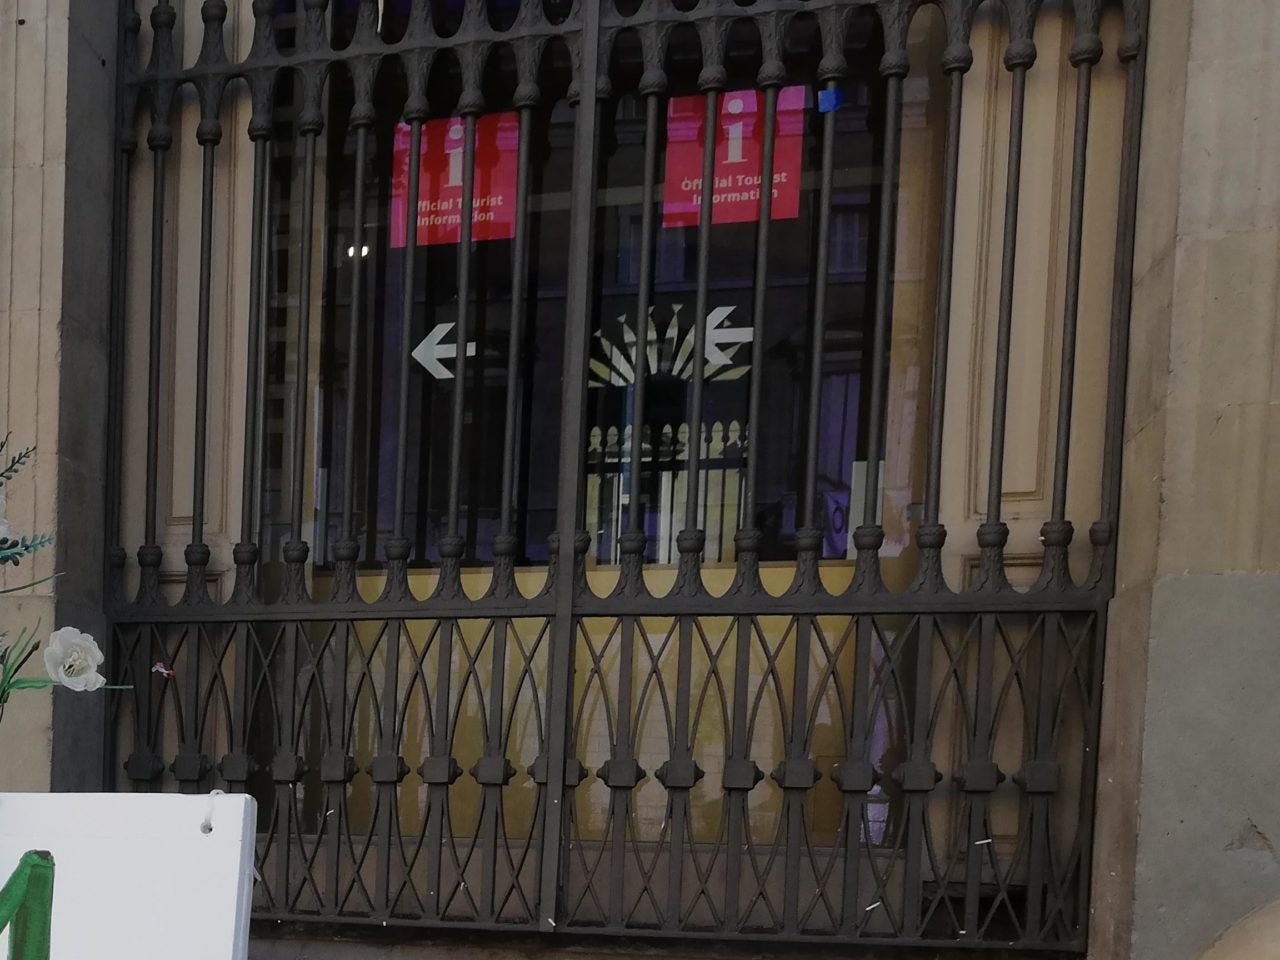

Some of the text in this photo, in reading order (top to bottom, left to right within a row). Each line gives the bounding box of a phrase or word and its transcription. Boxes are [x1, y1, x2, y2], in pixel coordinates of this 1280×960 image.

[680, 172, 788, 191] Offial Toust
[456, 195, 503, 209] Turist
